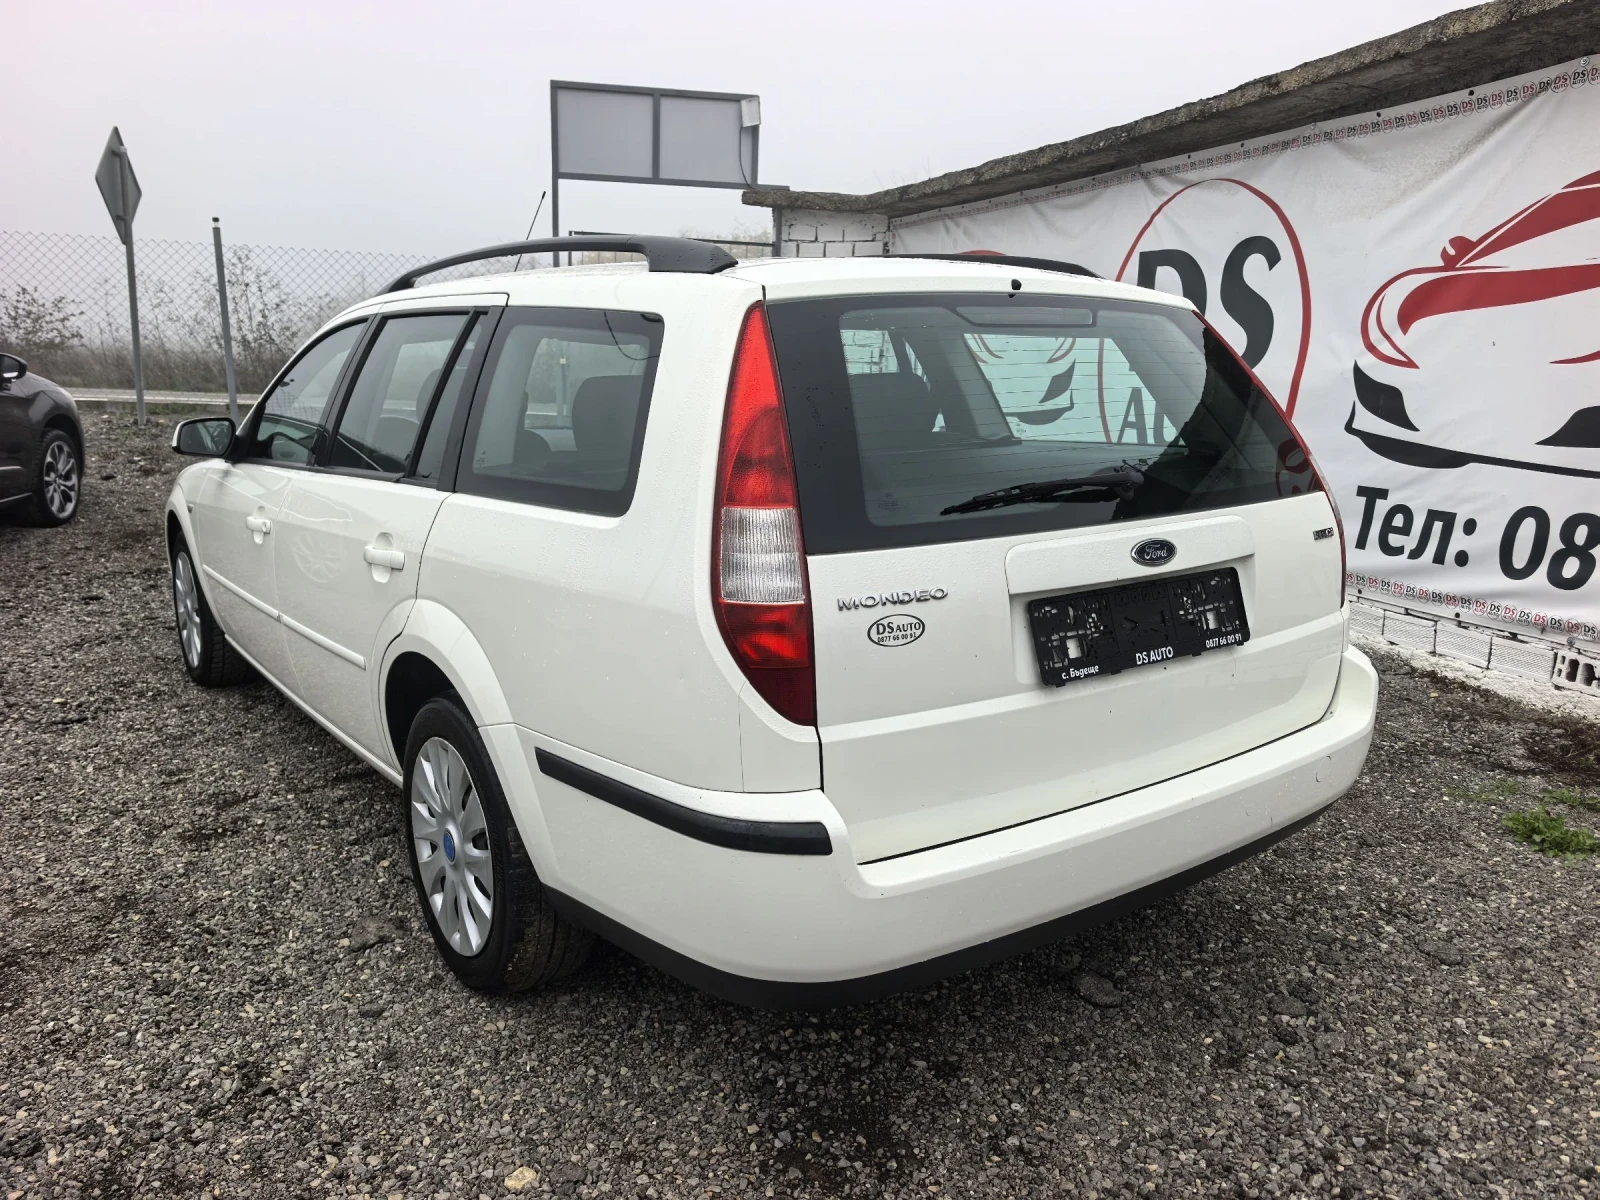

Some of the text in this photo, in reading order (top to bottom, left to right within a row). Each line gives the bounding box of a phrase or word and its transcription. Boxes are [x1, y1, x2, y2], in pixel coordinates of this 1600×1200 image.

[1573, 70, 1586, 79] DS
[1591, 68, 1600, 76] D
[1554, 75, 1568, 84] DS
[1522, 84, 1534, 94] DS
[1539, 80, 1550, 90] DS
[1492, 92, 1502, 102] DS
[1507, 89, 1518, 98] DS
[1462, 100, 1473, 108] DS
[1477, 96, 1488, 105] DS
[1447, 104, 1458, 112] DS
[1355, 485, 1600, 590] Тел: 08
[1144, 544, 1168, 560] Ford
[837, 588, 948, 612] MONDEO
[1475, 601, 1486, 609] DS
[1490, 604, 1500, 612] DS
[1504, 607, 1515, 616] DS
[1519, 611, 1531, 619] DS
[1534, 614, 1546, 623] DS
[1550, 618, 1562, 627] DS
[876, 622, 921, 635] DS AUTO
[1567, 622, 1579, 630] DS
[1584, 625, 1596, 634] DS
[1206, 634, 1242, 648] 0877 66 00 91
[1136, 646, 1174, 665] DS AUTO
[1070, 664, 1099, 678] Бъдеще
